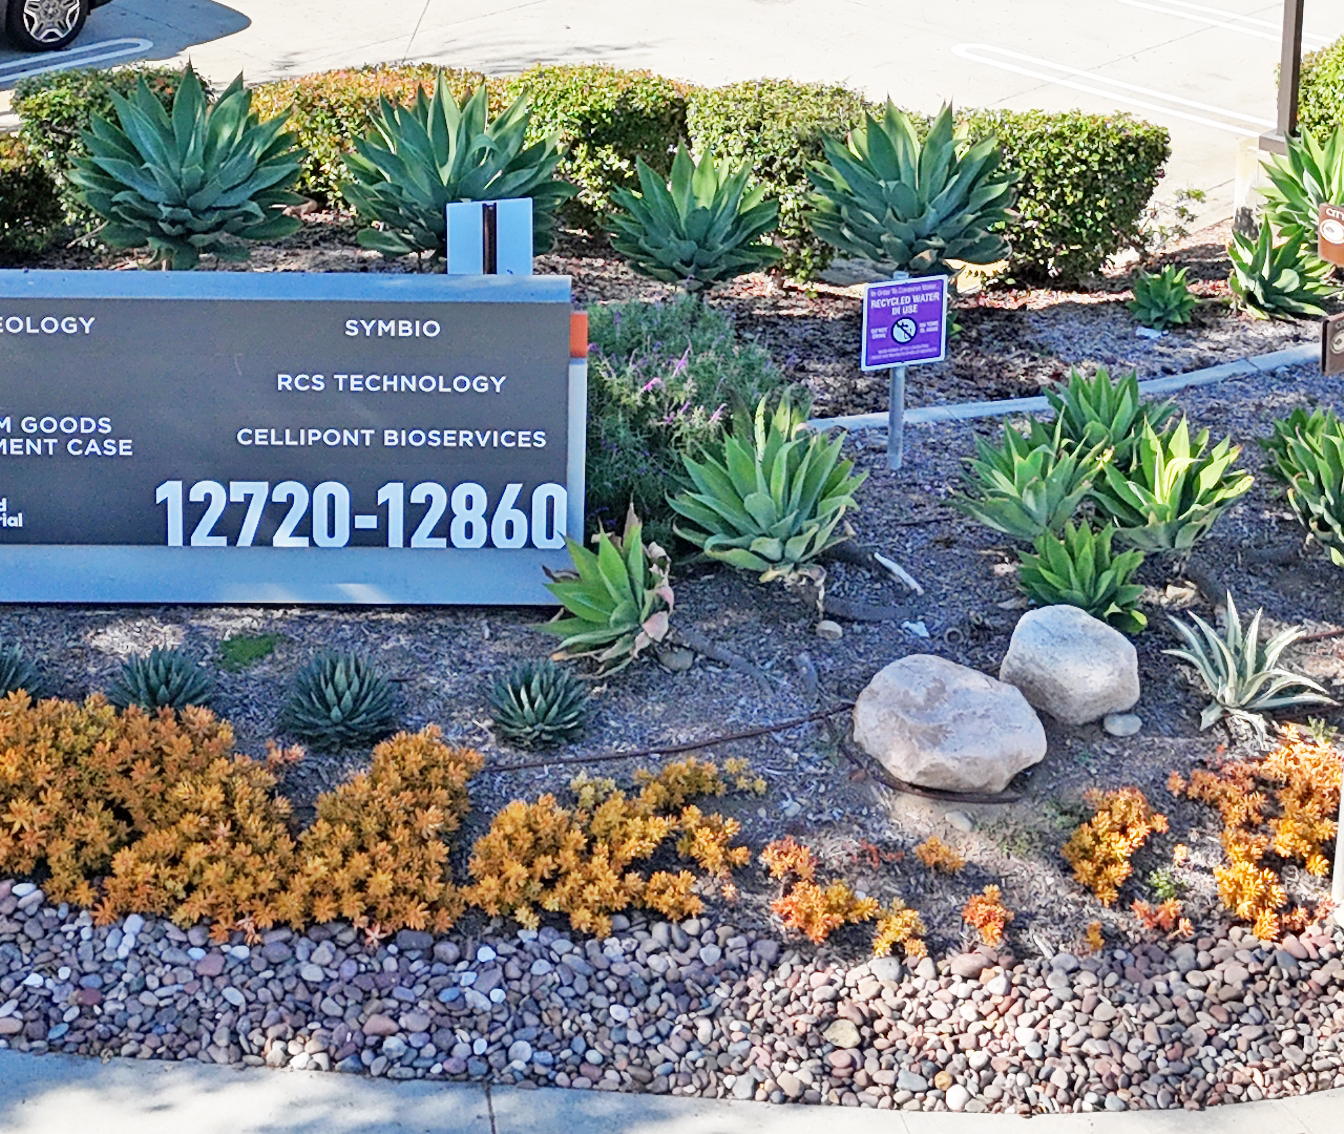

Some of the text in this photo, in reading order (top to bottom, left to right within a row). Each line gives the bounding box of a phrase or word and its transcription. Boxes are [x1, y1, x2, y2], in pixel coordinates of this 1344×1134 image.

[870, 292, 940, 309] RECYCLED WATER
[902, 304, 918, 314] USE
[344, 319, 441, 338] SYMBIO
[276, 373, 507, 394] RCS TECHNOLOGY
[21, 416, 112, 435] GOODS
[66, 438, 133, 457] CASE
[236, 428, 547, 448] CELLIPONT BIOSERVICES
[155, 479, 569, 550] 12720-12860
